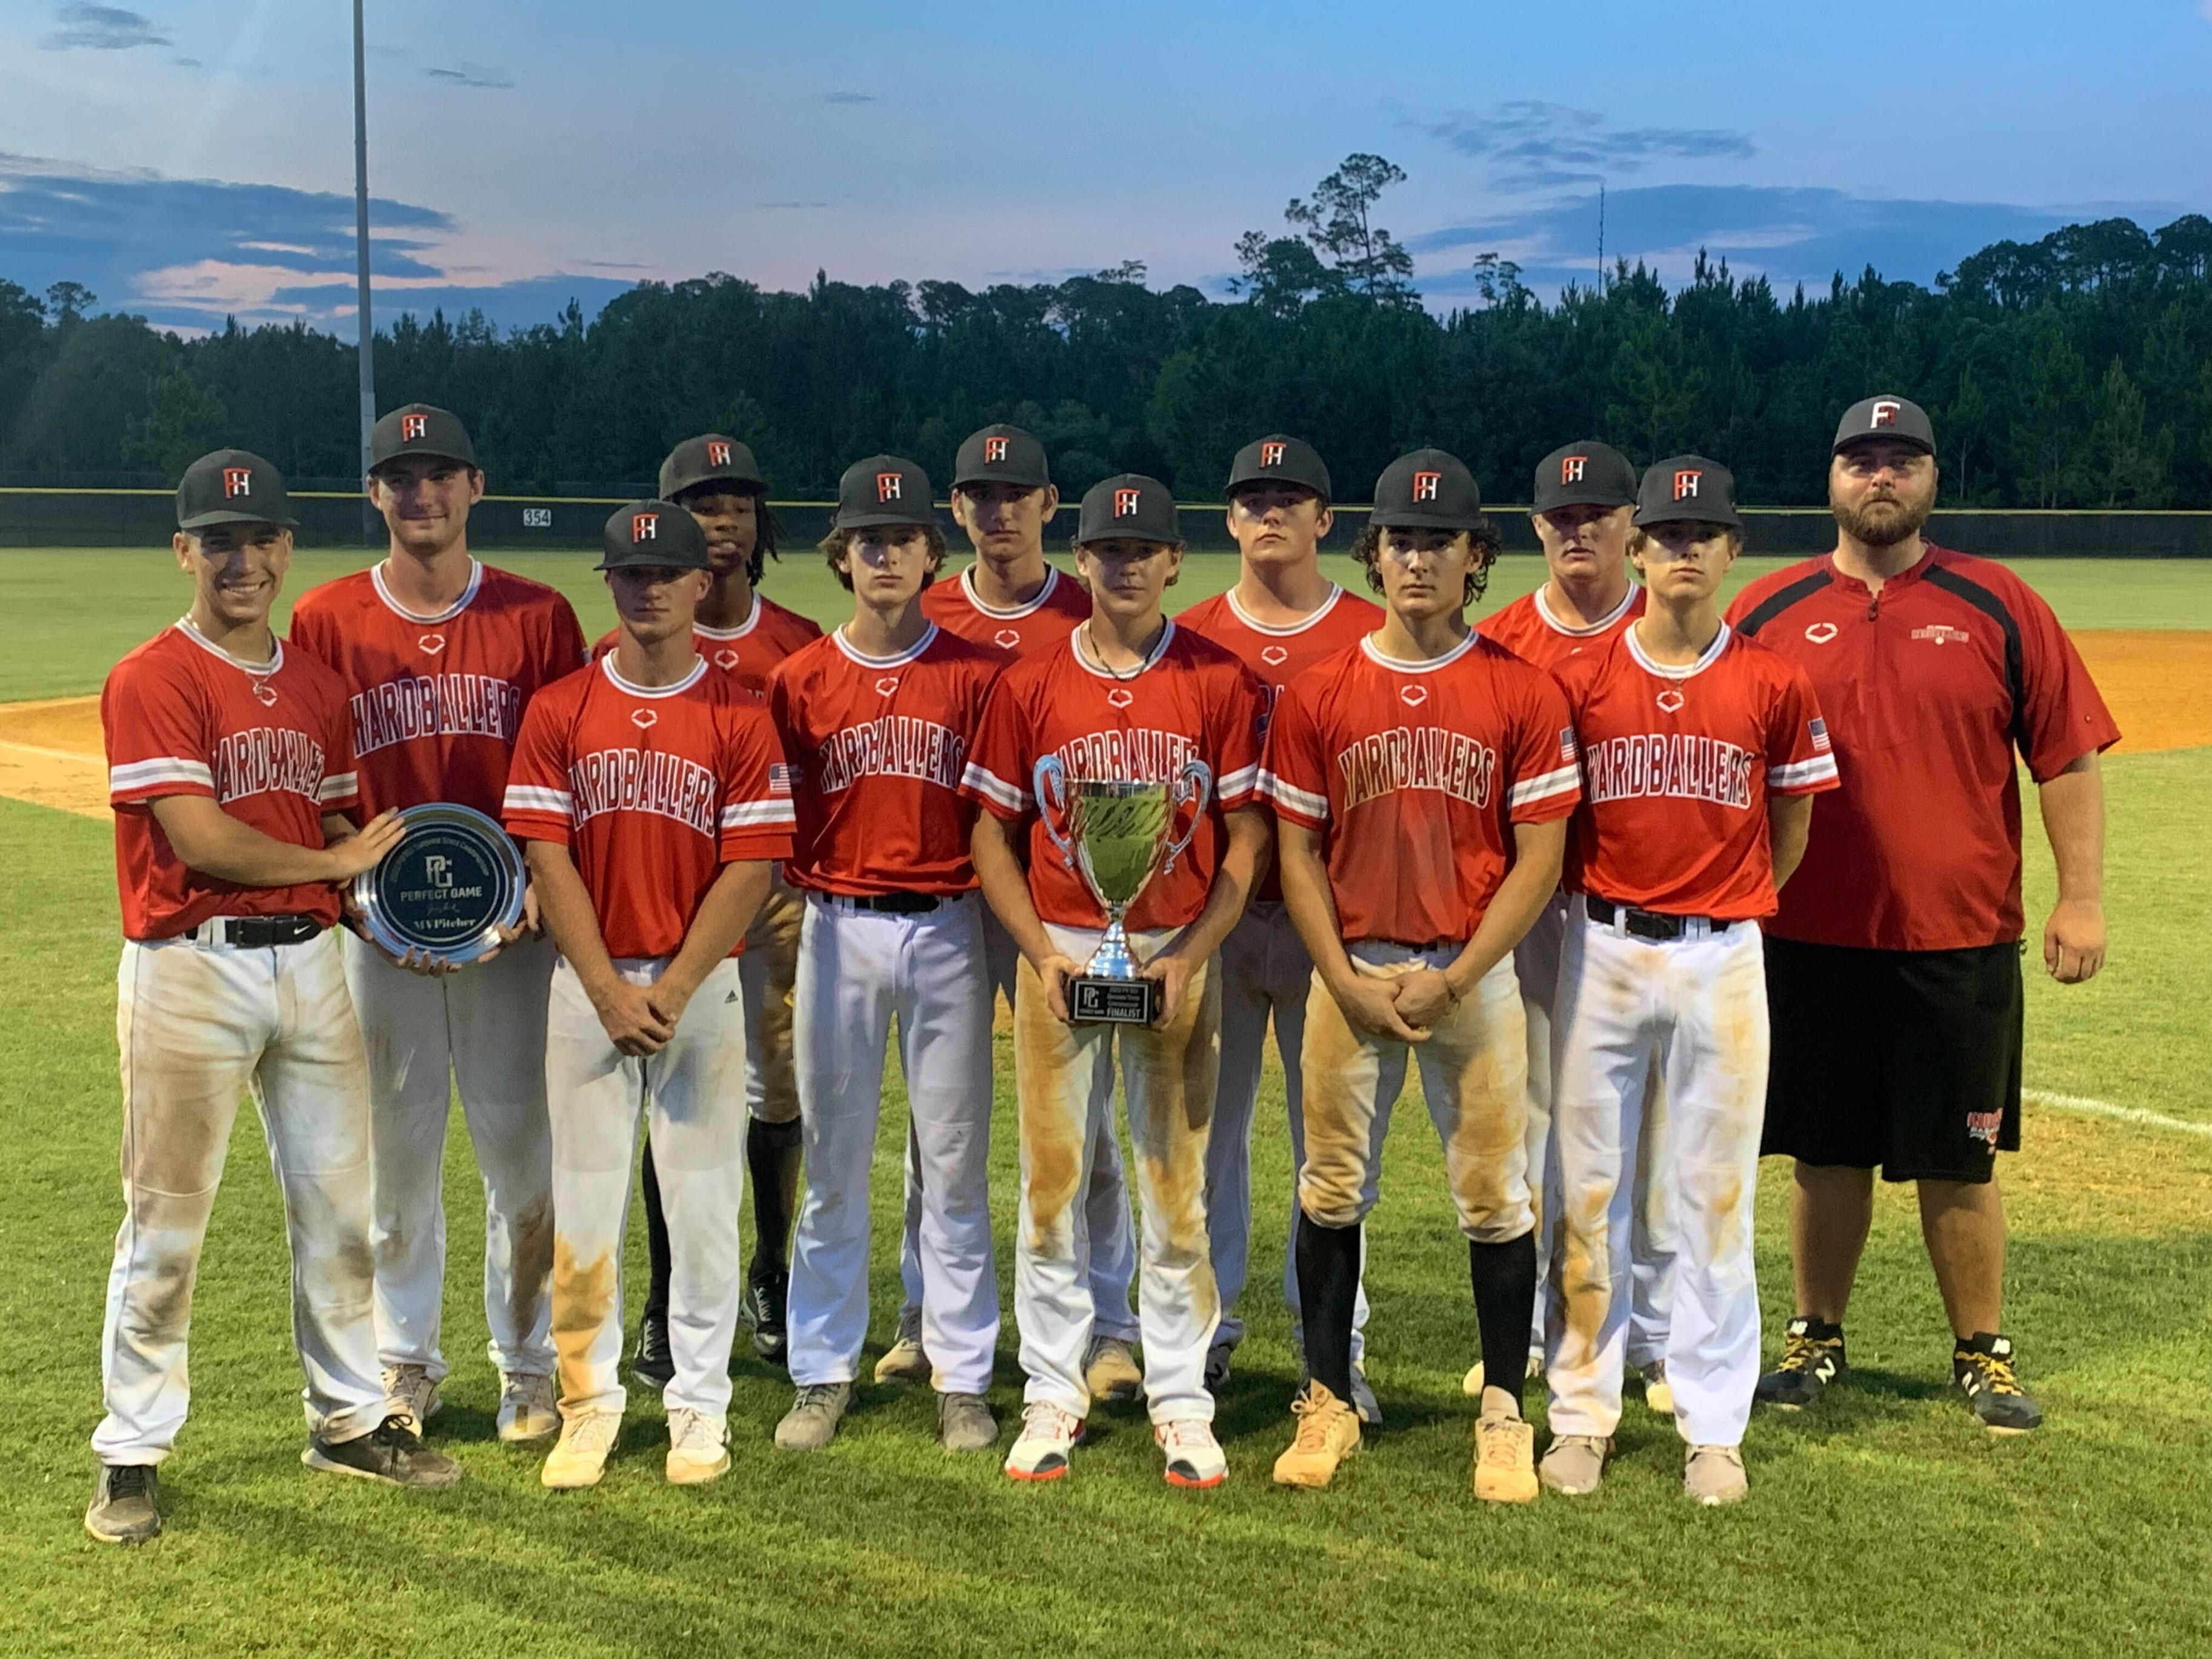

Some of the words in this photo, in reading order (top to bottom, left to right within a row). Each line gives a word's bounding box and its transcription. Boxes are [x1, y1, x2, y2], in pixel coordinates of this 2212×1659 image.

[525, 509, 549, 525] 354
[400, 889, 448, 902] PERFECT
[450, 886, 482, 899] GAME
[1107, 1007, 1141, 1019] FINALIST
